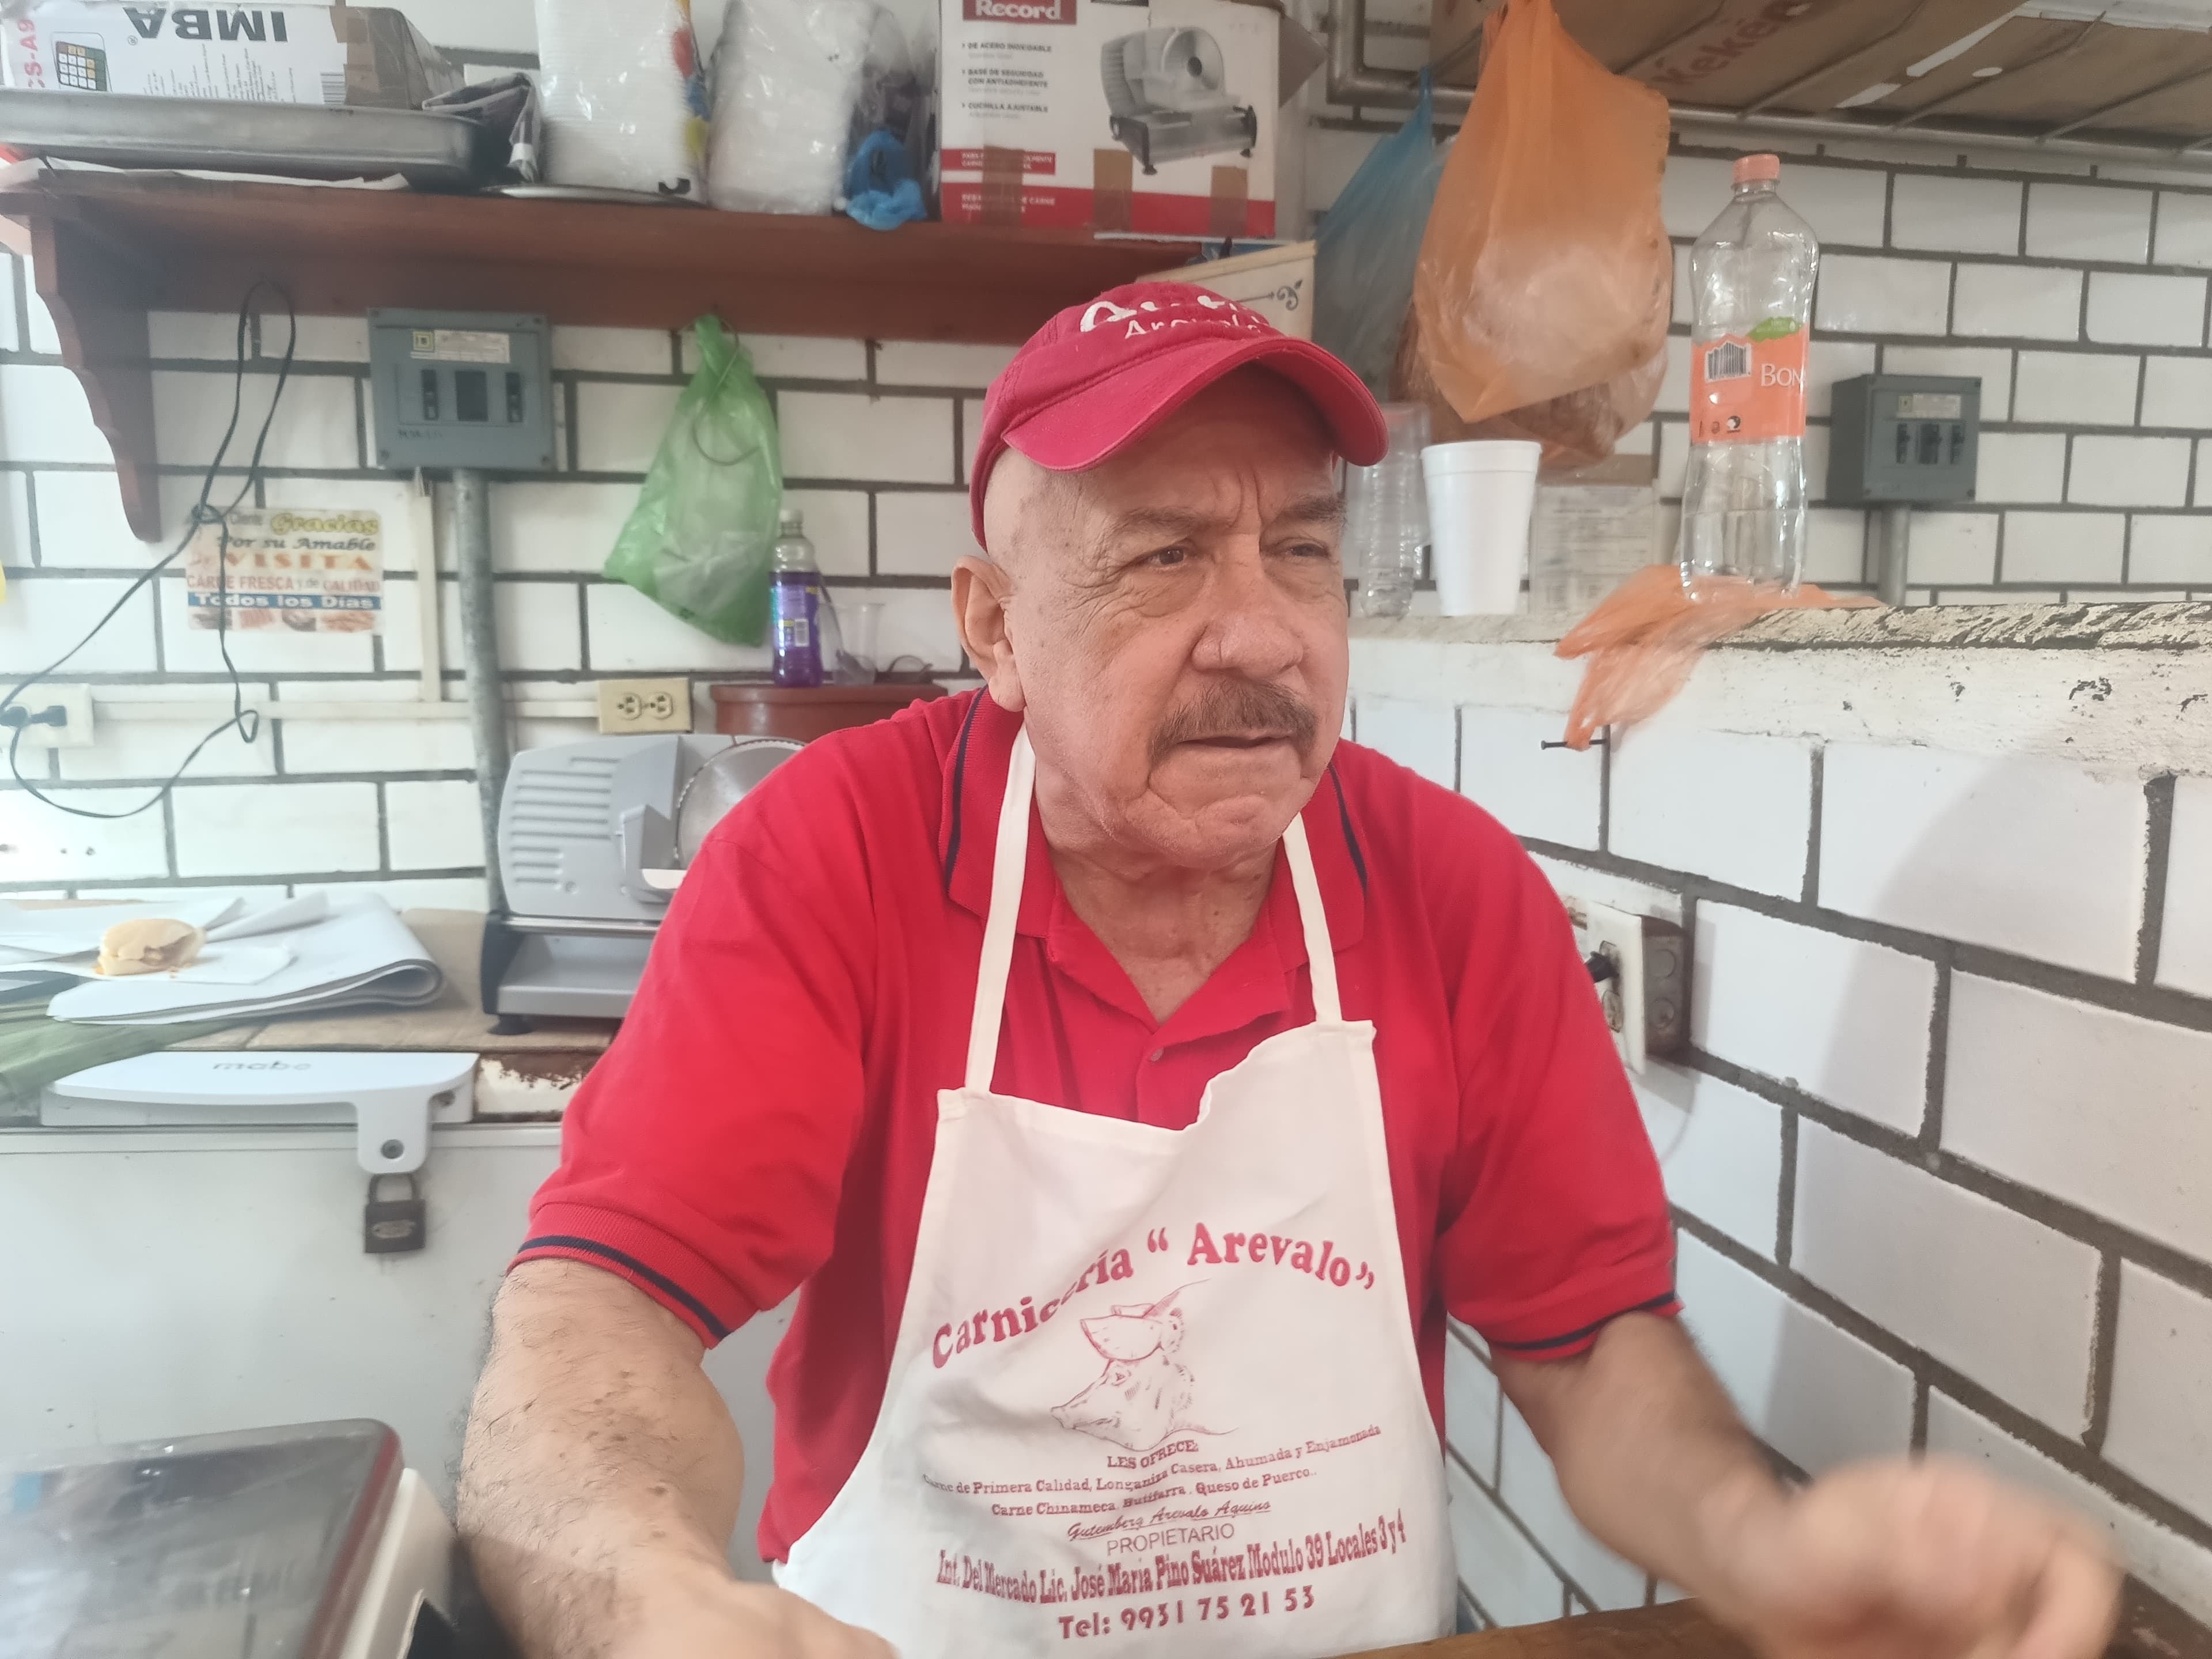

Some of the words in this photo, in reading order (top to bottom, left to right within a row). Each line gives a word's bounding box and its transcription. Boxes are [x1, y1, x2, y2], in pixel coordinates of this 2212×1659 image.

[976, 0, 1061, 20] Record
[123, 7, 288, 43] IMBA
[271, 512, 378, 535] Gracias
[264, 539, 285, 549] su
[293, 537, 376, 551] Amable
[225, 552, 373, 571] VISITA
[240, 576, 294, 590] FRESCA
[194, 593, 269, 606] Todos
[277, 594, 313, 607] los
[956, 1482, 971, 1494] de
[973, 1480, 1032, 1494] Primera
[1036, 1478, 1093, 1493] Calidad,
[1096, 1470, 1168, 1492] Longaniza
[1225, 1448, 1293, 1470] Ahumada
[1296, 1446, 1303, 1459] y
[1305, 1424, 1382, 1455] Enjamonada
[1107, 1456, 1137, 1469] LES
[991, 1503, 1033, 1516] Carne
[1195, 1480, 1239, 1497] Queso
[1242, 1477, 1259, 1490] de
[1149, 1506, 1209, 1524] Arevalo
[1214, 1499, 1271, 1518] Aquino
[1107, 1522, 1235, 1556] PROPIETARIO
[963, 1555, 983, 1592] Del
[984, 1560, 1037, 1603] Mercado
[1040, 1567, 1067, 1604] Lic.
[1071, 1563, 1105, 1601] José
[1155, 1553, 1189, 1590] Pino
[1191, 1545, 1246, 1585] Suárez
[1247, 1538, 1304, 1579] Modulo
[1305, 1532, 1324, 1570] 39
[1325, 1522, 1378, 1566] Locales
[1378, 1514, 1388, 1550] 3
[1388, 1520, 1397, 1554] y
[1397, 1508, 1407, 1543] 4
[1058, 1611, 1111, 1639] Tel:
[1120, 1599, 1184, 1631] 9931
[1198, 1595, 1229, 1621] 75
[1240, 1590, 1270, 1616] 21
[1285, 1585, 1315, 1612] 53
